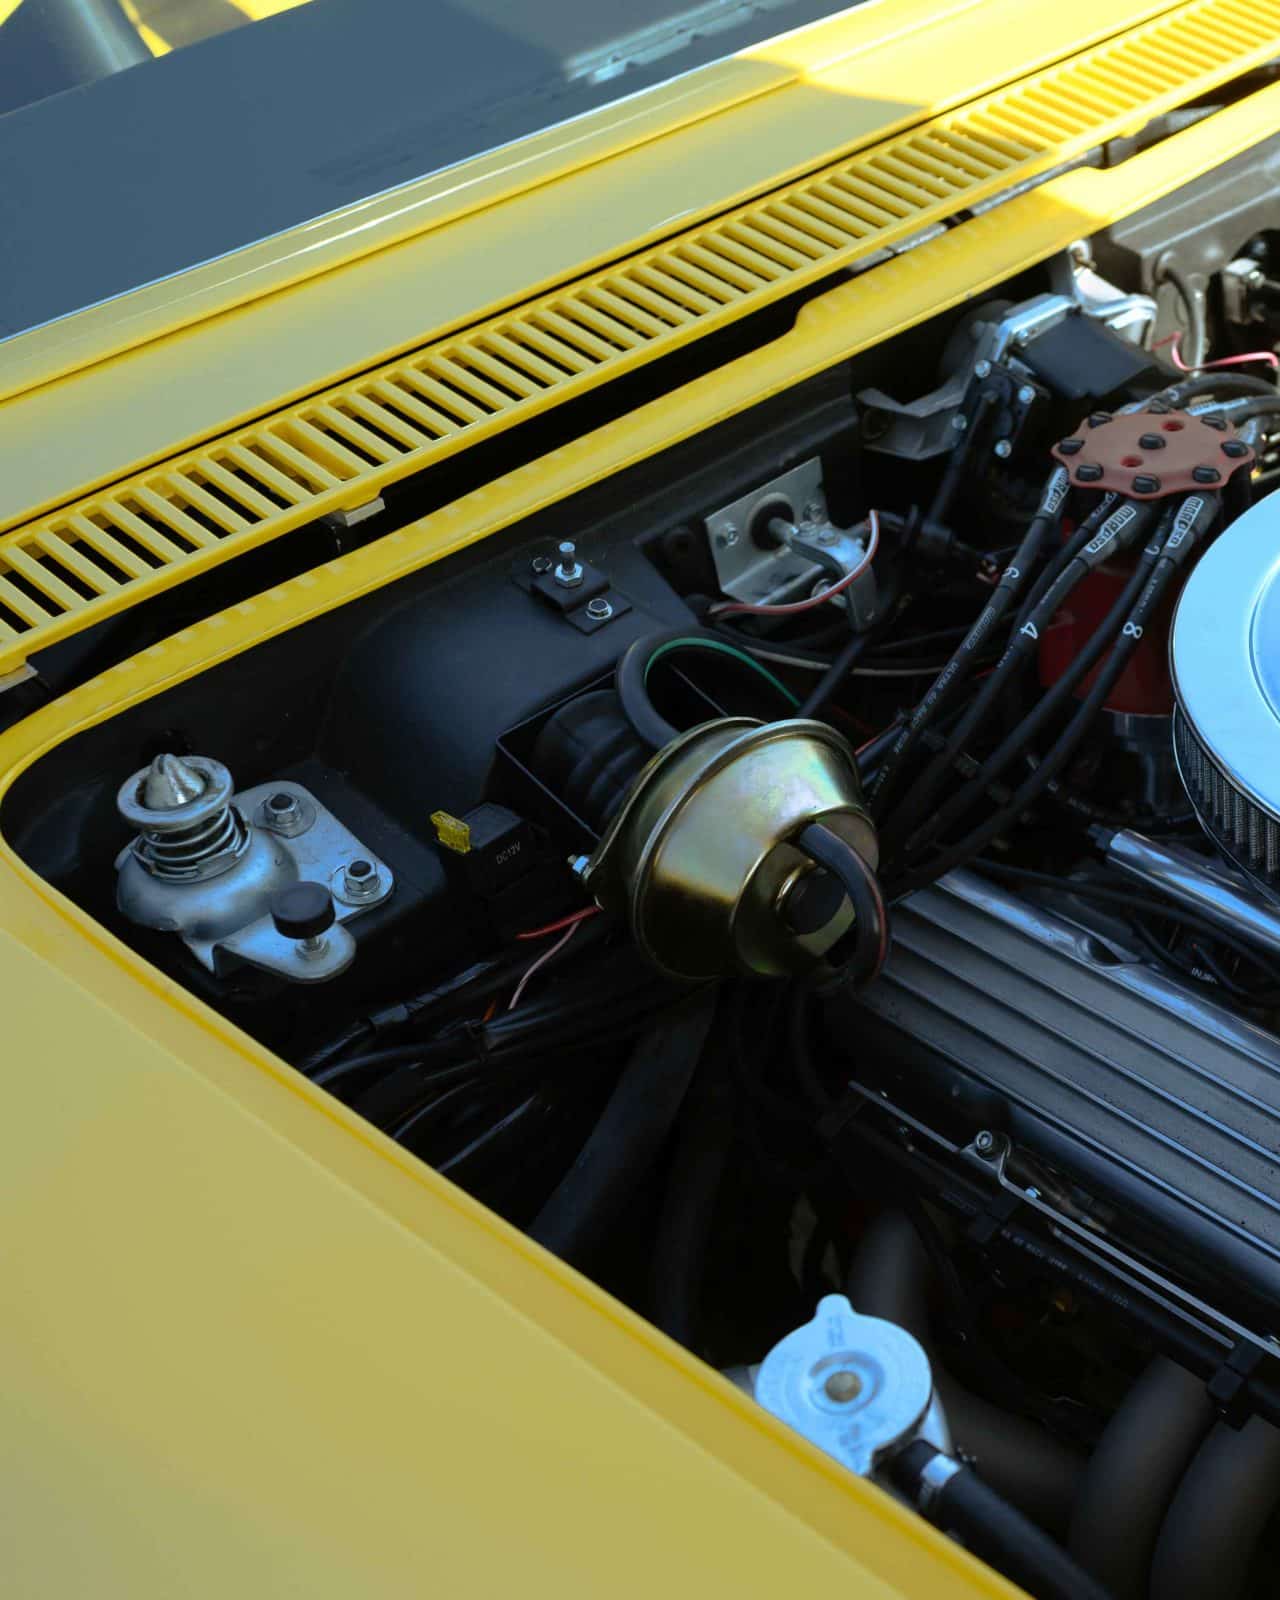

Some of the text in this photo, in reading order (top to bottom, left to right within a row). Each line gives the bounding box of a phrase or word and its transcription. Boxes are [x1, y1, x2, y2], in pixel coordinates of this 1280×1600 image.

[1089, 506, 1133, 552] MOROSO
[1171, 497, 1202, 546] MOROSO
[1020, 621, 1039, 640] 4
[1122, 621, 1144, 639] 8
